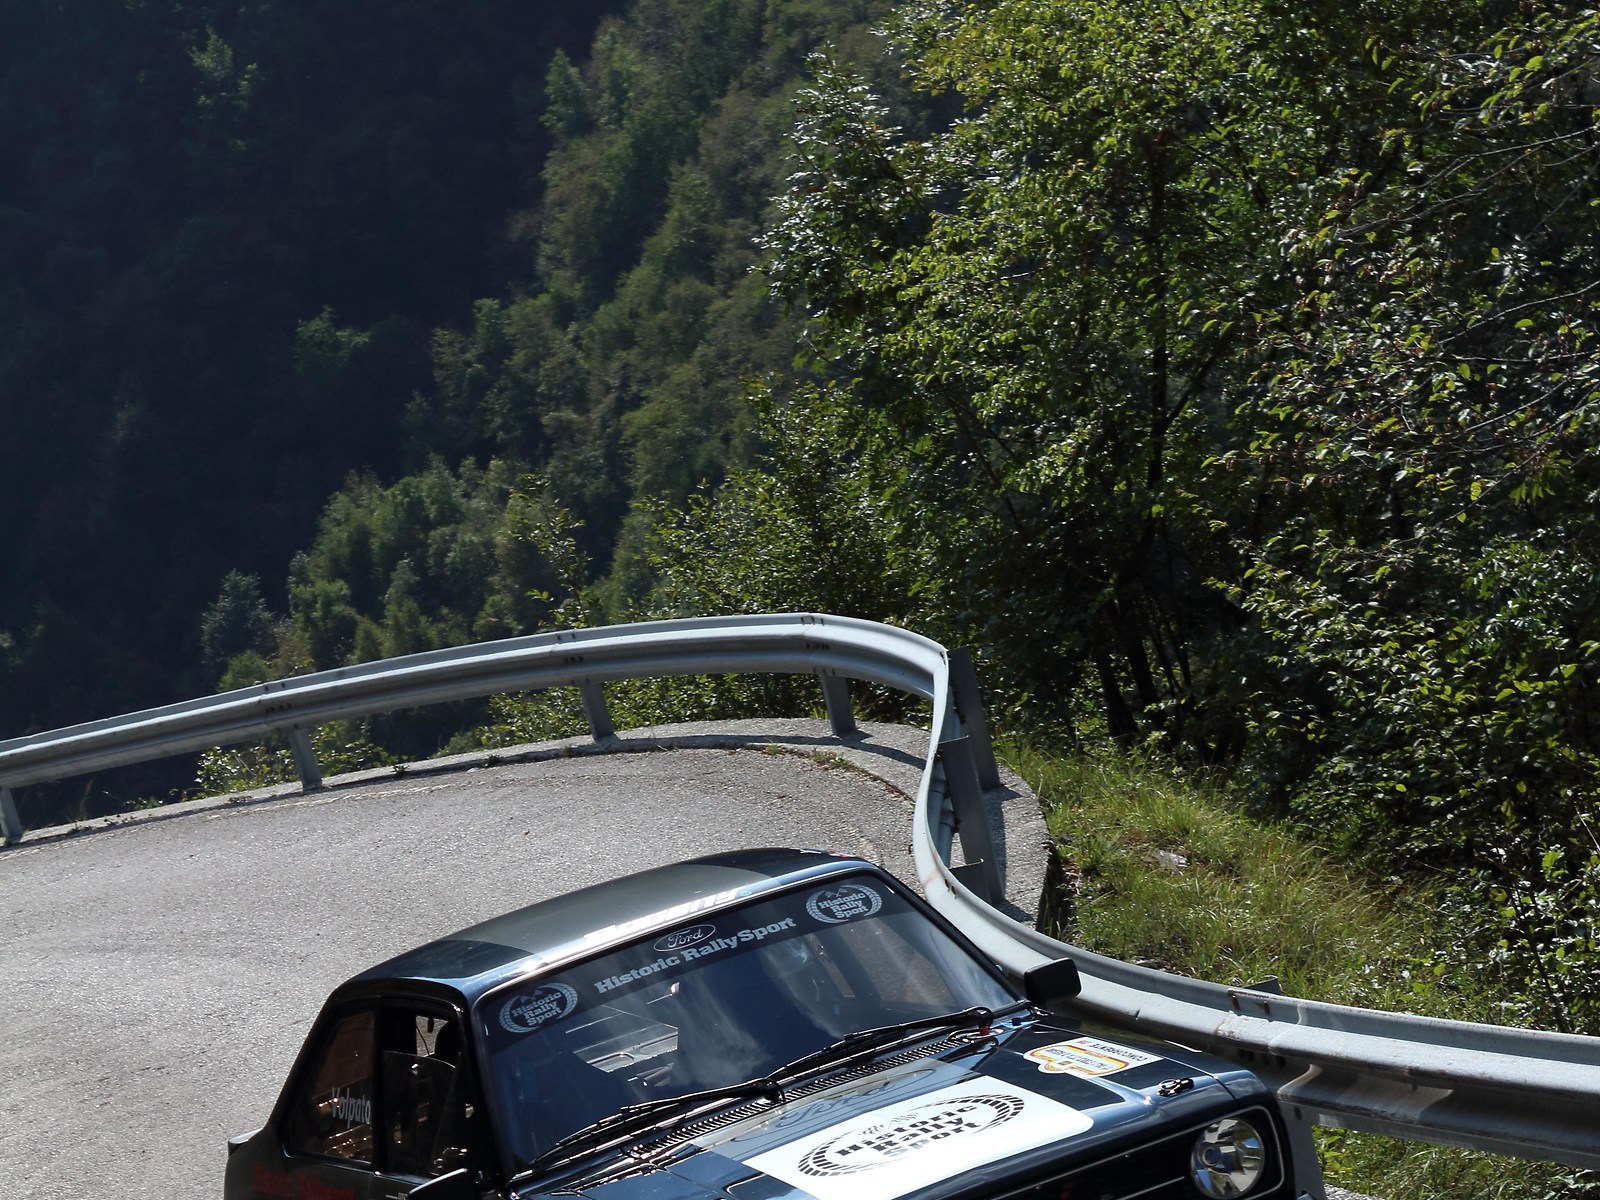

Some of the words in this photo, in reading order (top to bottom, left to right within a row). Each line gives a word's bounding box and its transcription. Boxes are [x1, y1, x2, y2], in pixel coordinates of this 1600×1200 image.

[817, 892, 866, 909] Historic
[830, 900, 863, 913] Rally
[834, 905, 869, 919] Sport
[667, 926, 704, 948] Ford
[594, 954, 680, 994] Historic
[511, 992, 562, 1017] Historic
[523, 1001, 557, 1019] Rally
[526, 1007, 563, 1026] Sport
[331, 1087, 372, 1128] Volpato
[836, 1105, 978, 1156] Historic
[871, 1117, 966, 1153] Rally
[882, 1120, 980, 1157] Sport
